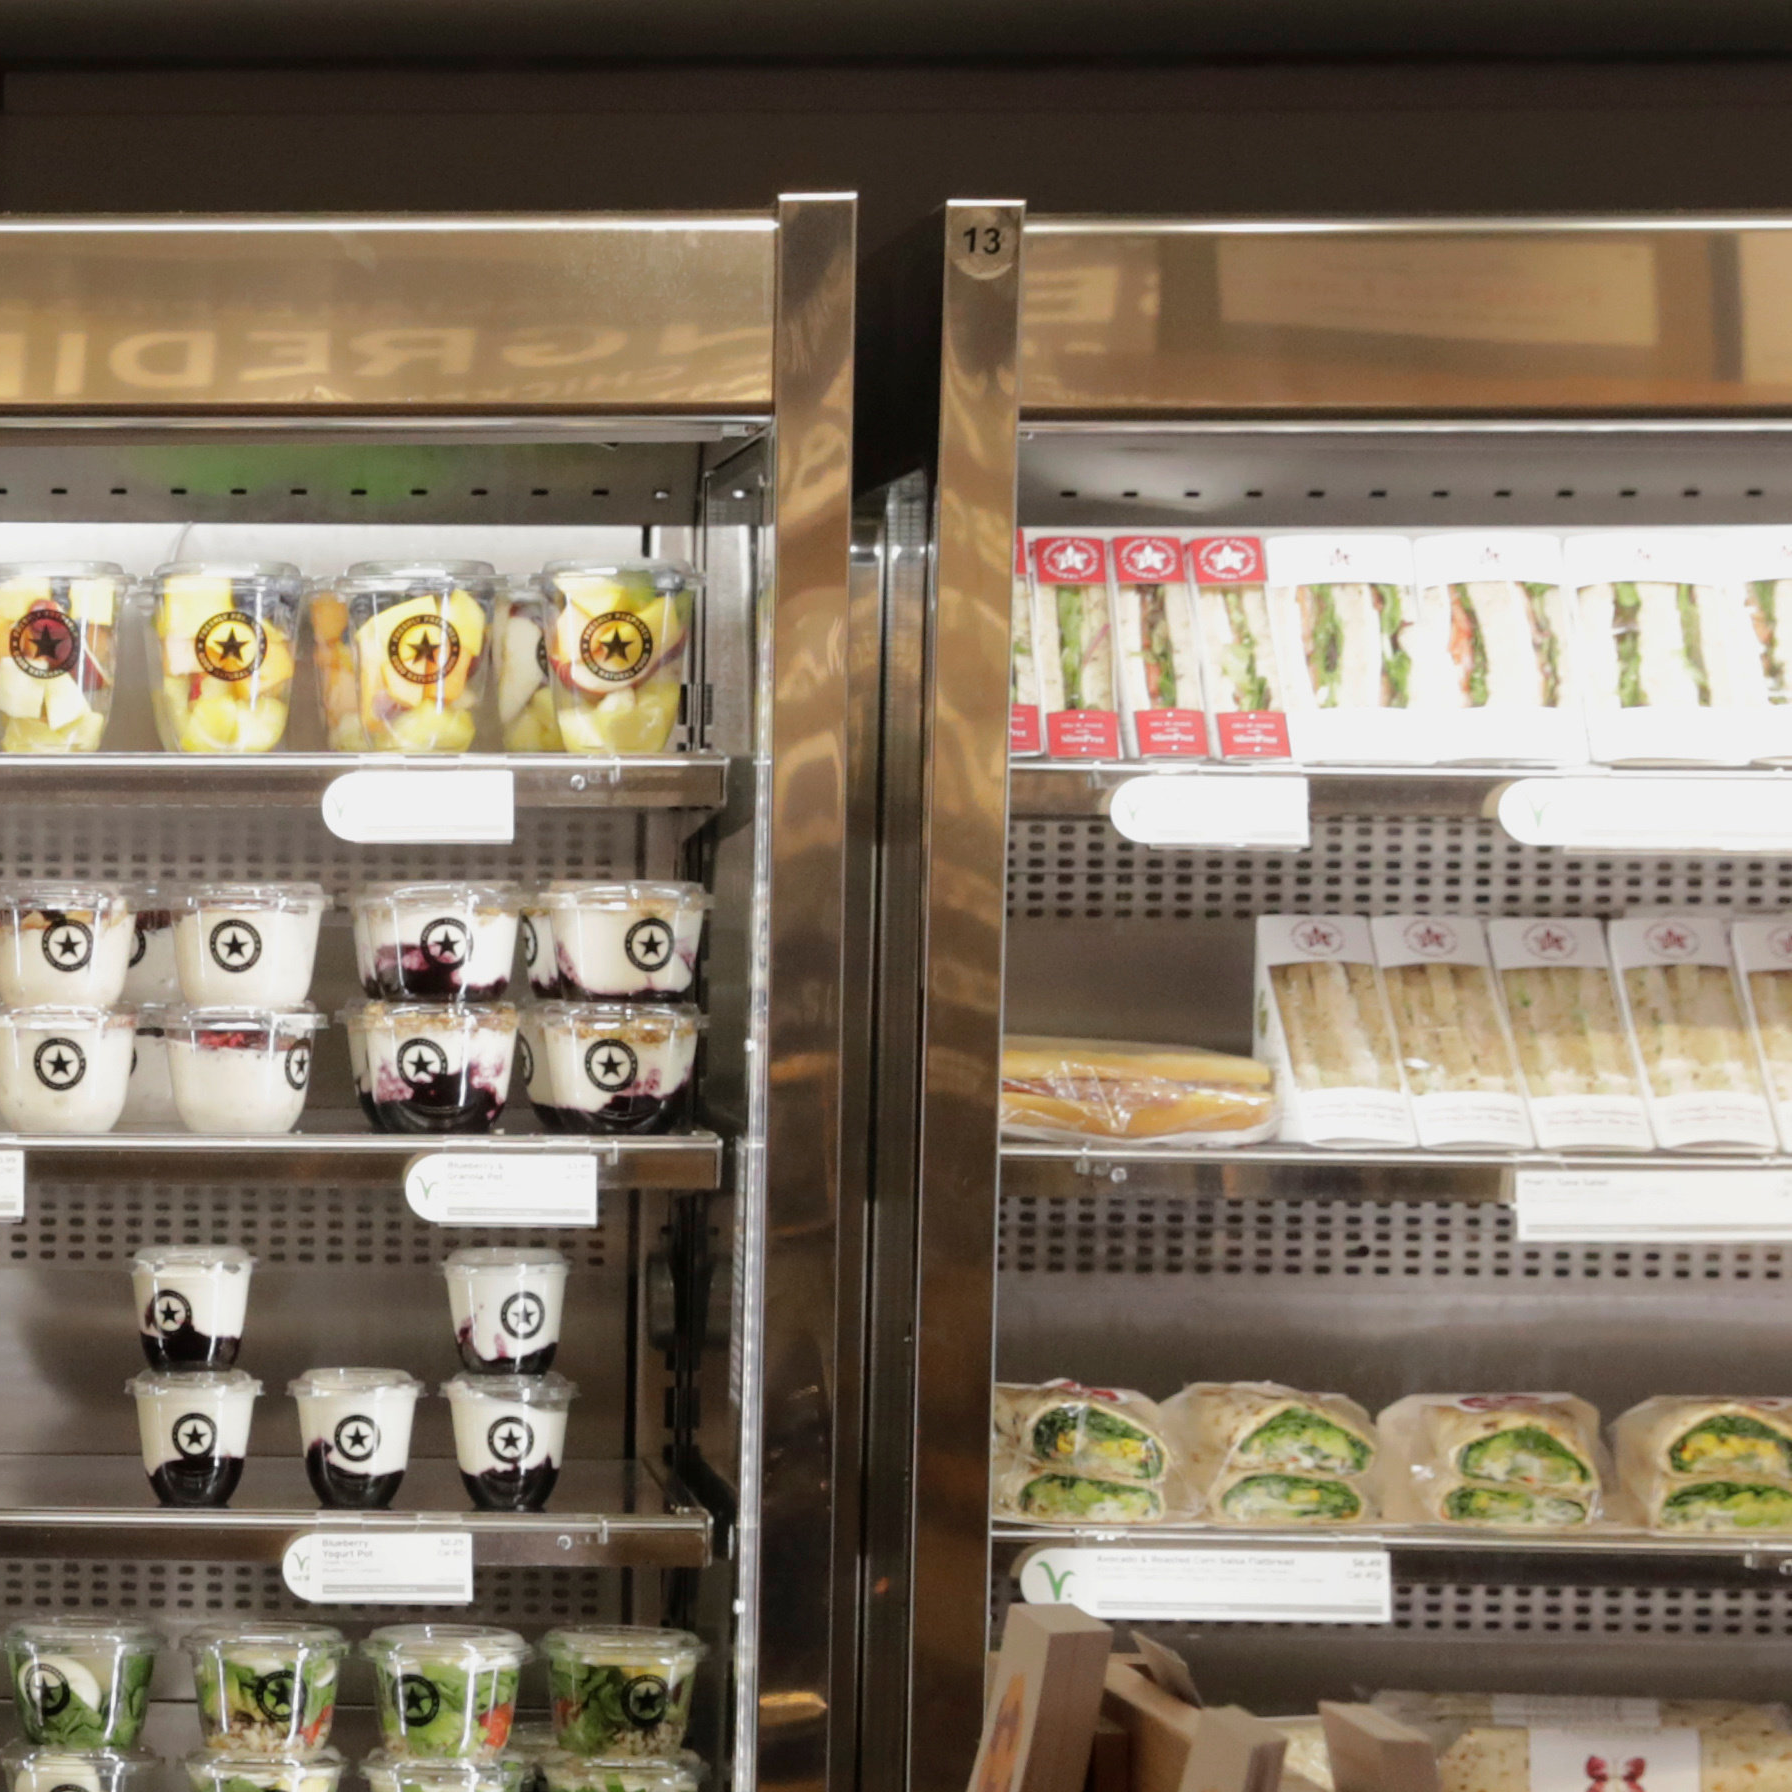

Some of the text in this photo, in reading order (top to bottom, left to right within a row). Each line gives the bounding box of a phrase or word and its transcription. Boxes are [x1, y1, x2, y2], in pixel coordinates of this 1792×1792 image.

[963, 227, 1000, 255] 13
[321, 1539, 368, 1551] Blueberry
[323, 1549, 373, 1561] Yogurt Pot
